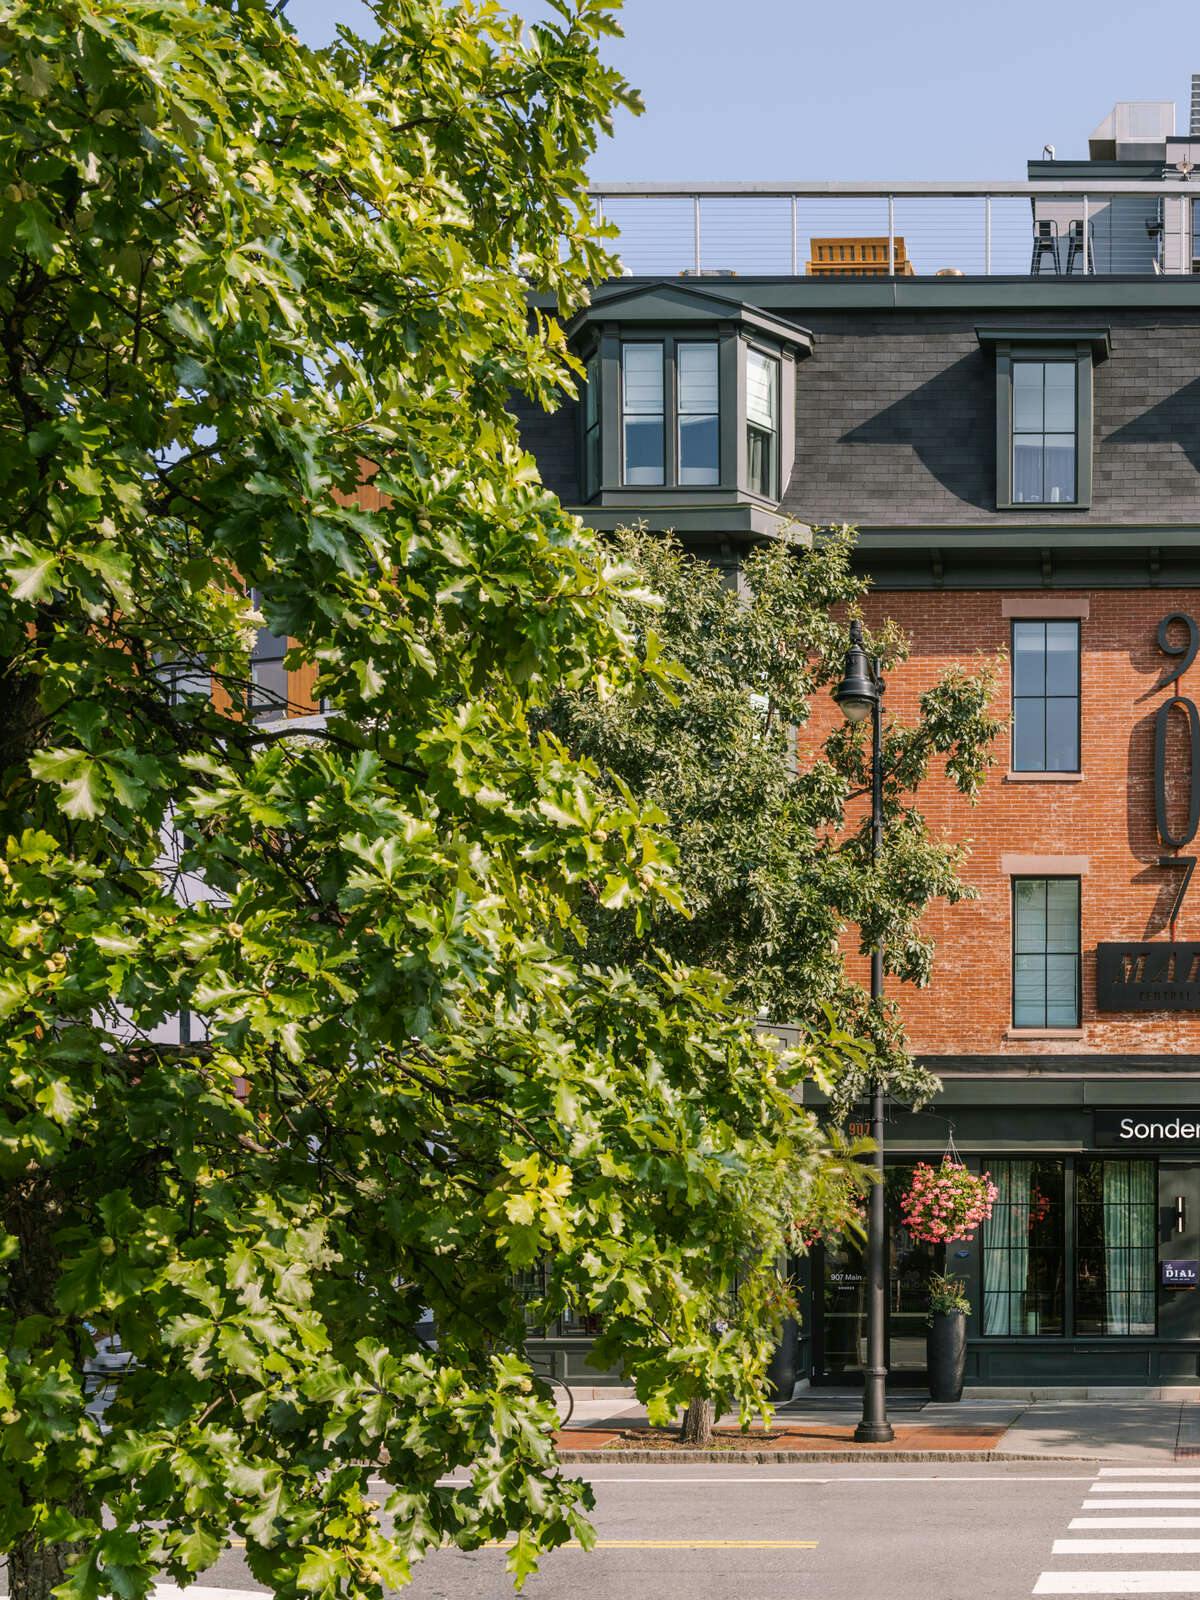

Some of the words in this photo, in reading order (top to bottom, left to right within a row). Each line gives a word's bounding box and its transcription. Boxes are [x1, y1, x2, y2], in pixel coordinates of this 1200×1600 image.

[1138, 991, 1193, 1002] CENTRAL
[830, 1273, 845, 1281] 907
[845, 1273, 863, 1281] Main
[1165, 1269, 1196, 1278] DIAL
